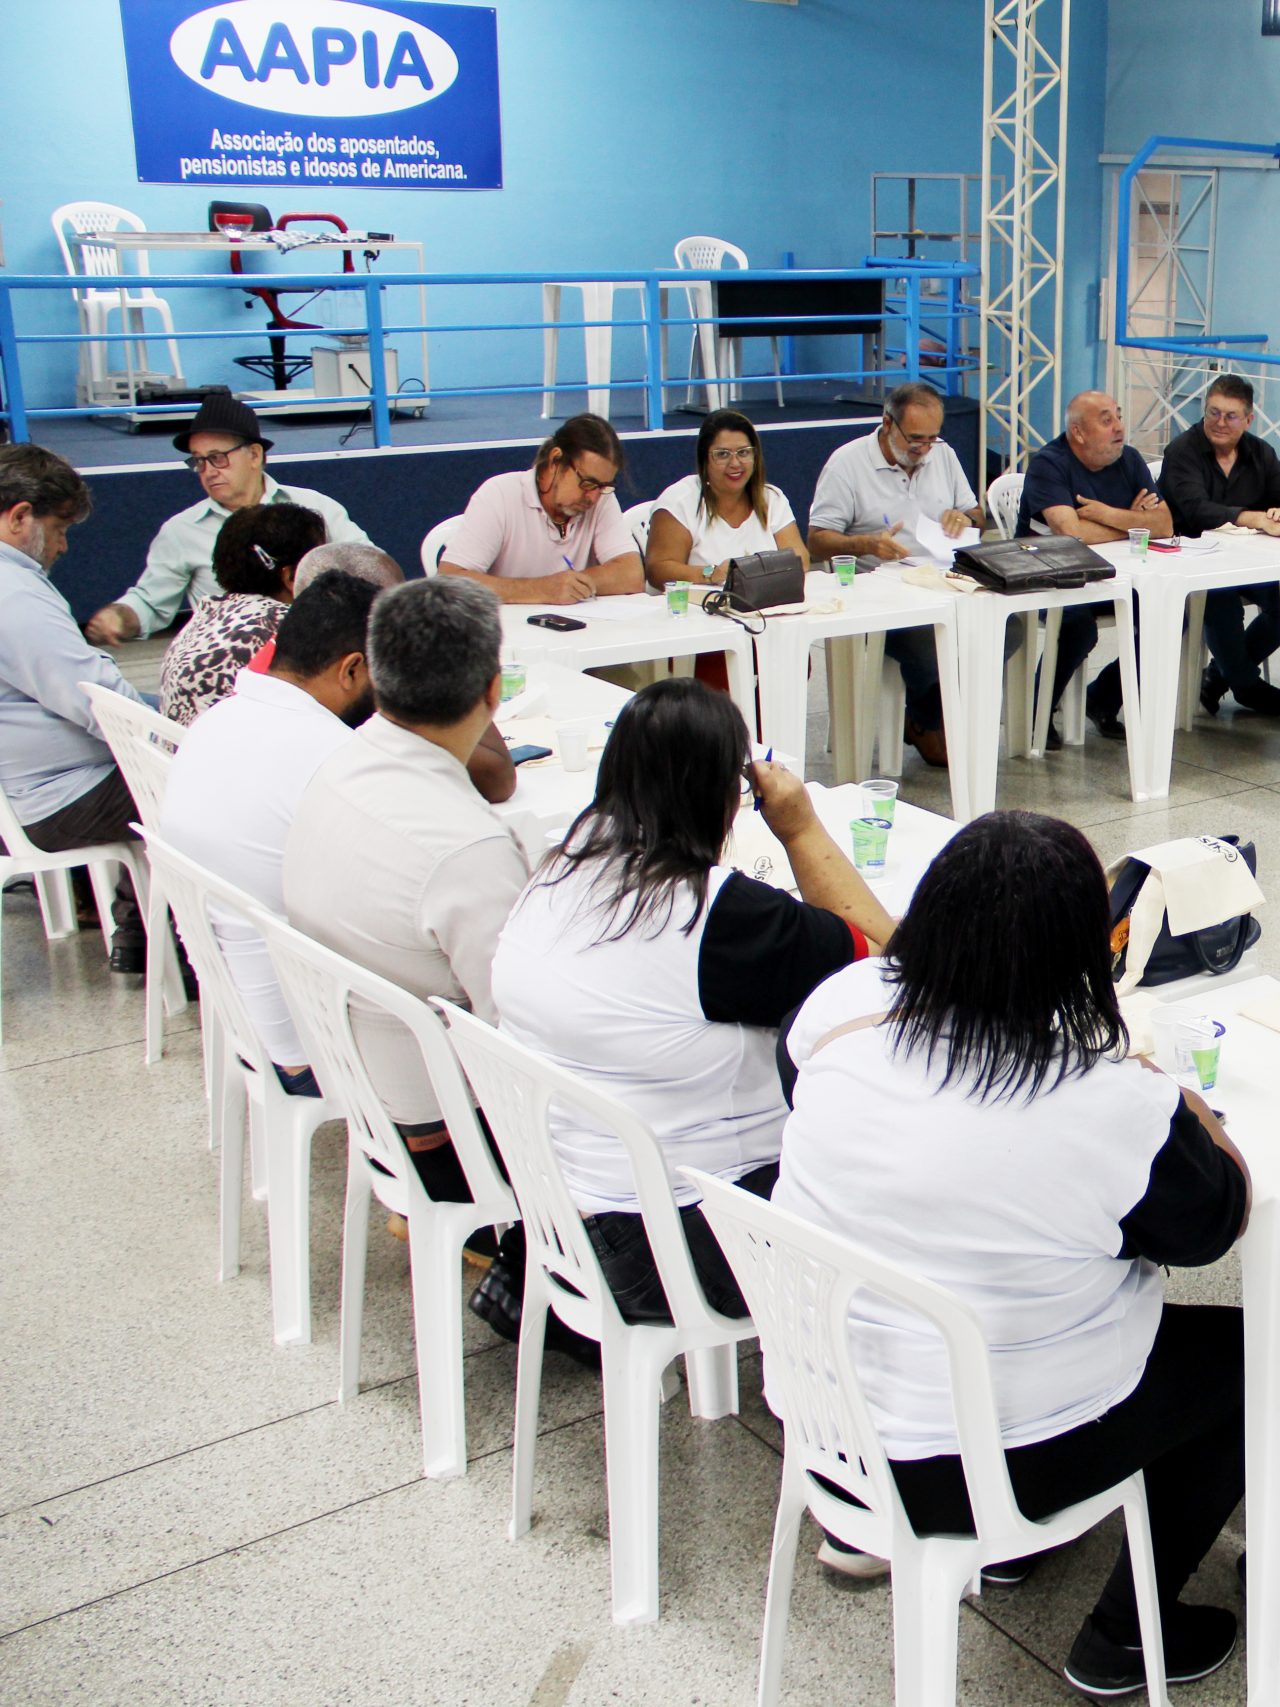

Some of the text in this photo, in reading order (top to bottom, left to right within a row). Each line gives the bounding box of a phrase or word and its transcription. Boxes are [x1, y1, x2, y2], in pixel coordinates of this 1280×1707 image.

[200, 17, 434, 91] AAPIA
[210, 128, 440, 159] Associação dos aposentados,
[179, 154, 468, 180] pensionistas e idosos de Americana.
